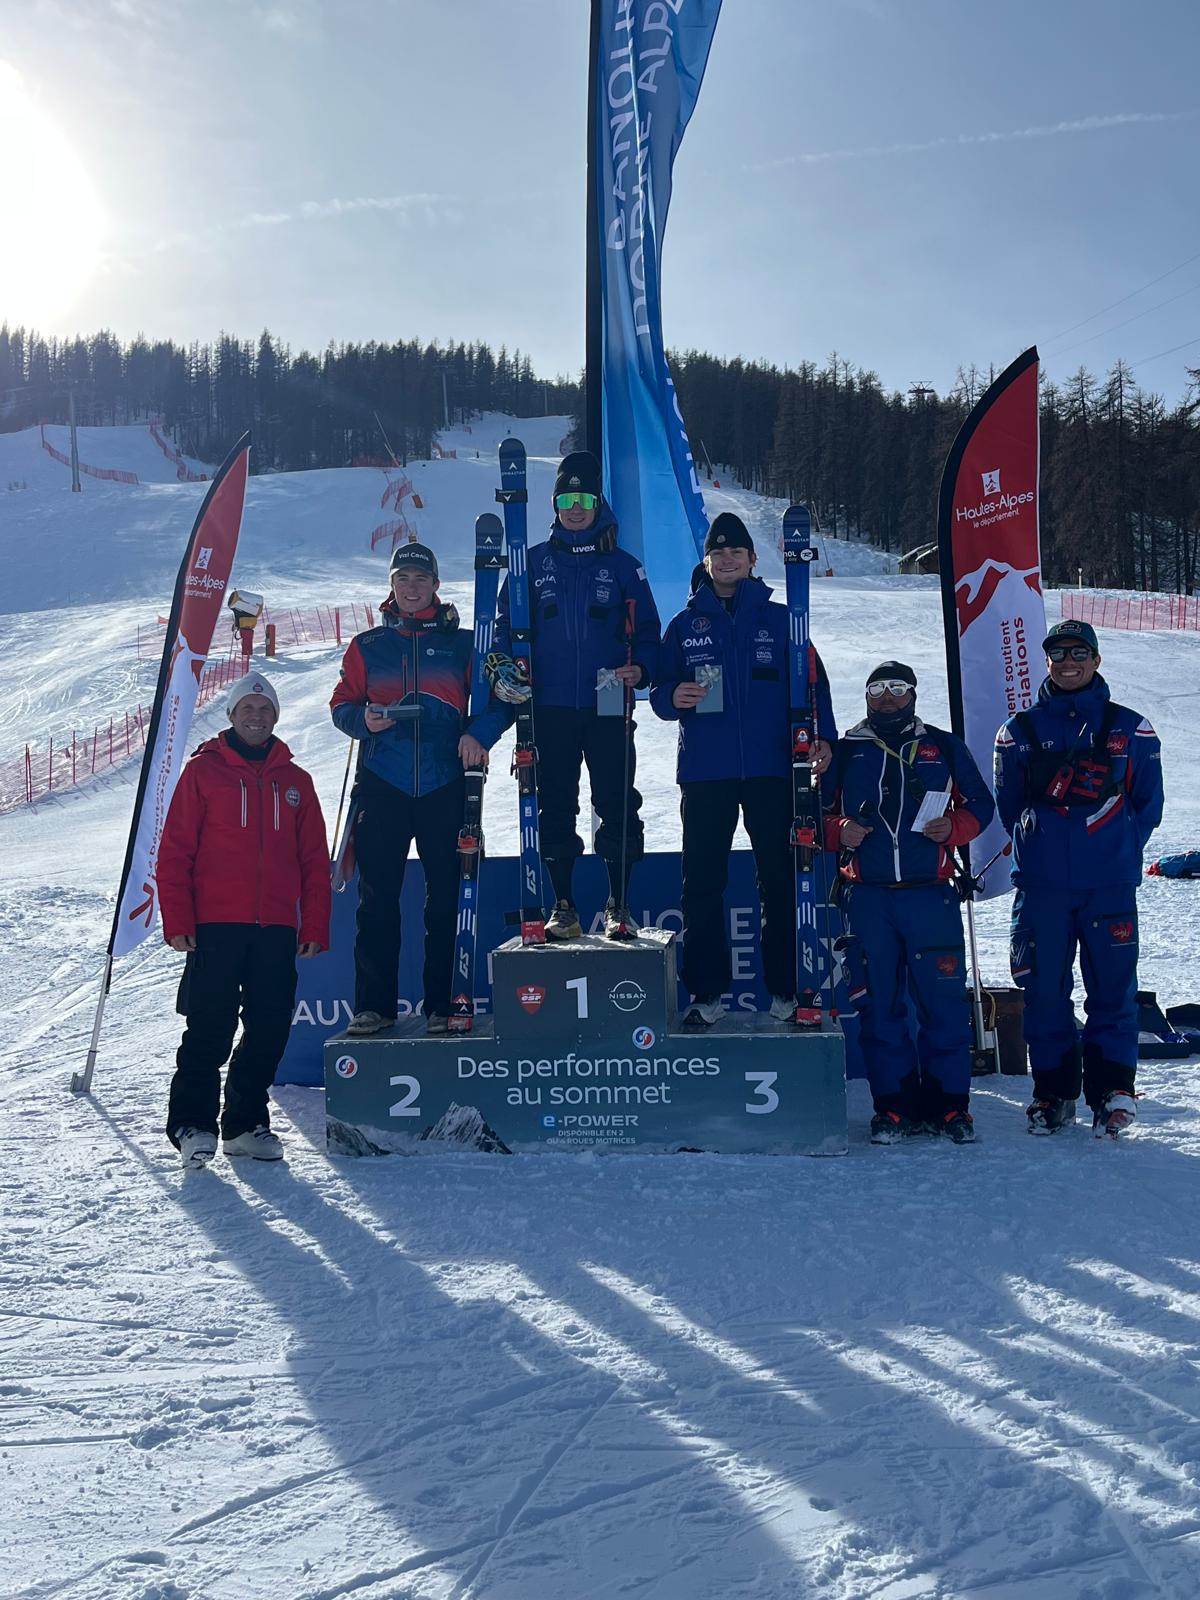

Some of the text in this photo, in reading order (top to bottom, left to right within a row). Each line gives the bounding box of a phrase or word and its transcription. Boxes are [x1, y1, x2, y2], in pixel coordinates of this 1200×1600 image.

[956, 491, 1034, 522] Hautes-Alpes
[572, 544, 596, 553] uvex
[1000, 620, 1013, 682] soutient
[1013, 616, 1032, 710] ciations
[566, 976, 589, 1019] 1
[457, 1053, 721, 1083] Des performances
[388, 1075, 421, 1117] 2
[506, 1082, 672, 1105] au sommet
[744, 1071, 779, 1114] 3
[558, 1129, 604, 1137] DISPONIBLE
[567, 1137, 594, 1145] ROUES
[595, 1137, 636, 1145] MOTRICES
